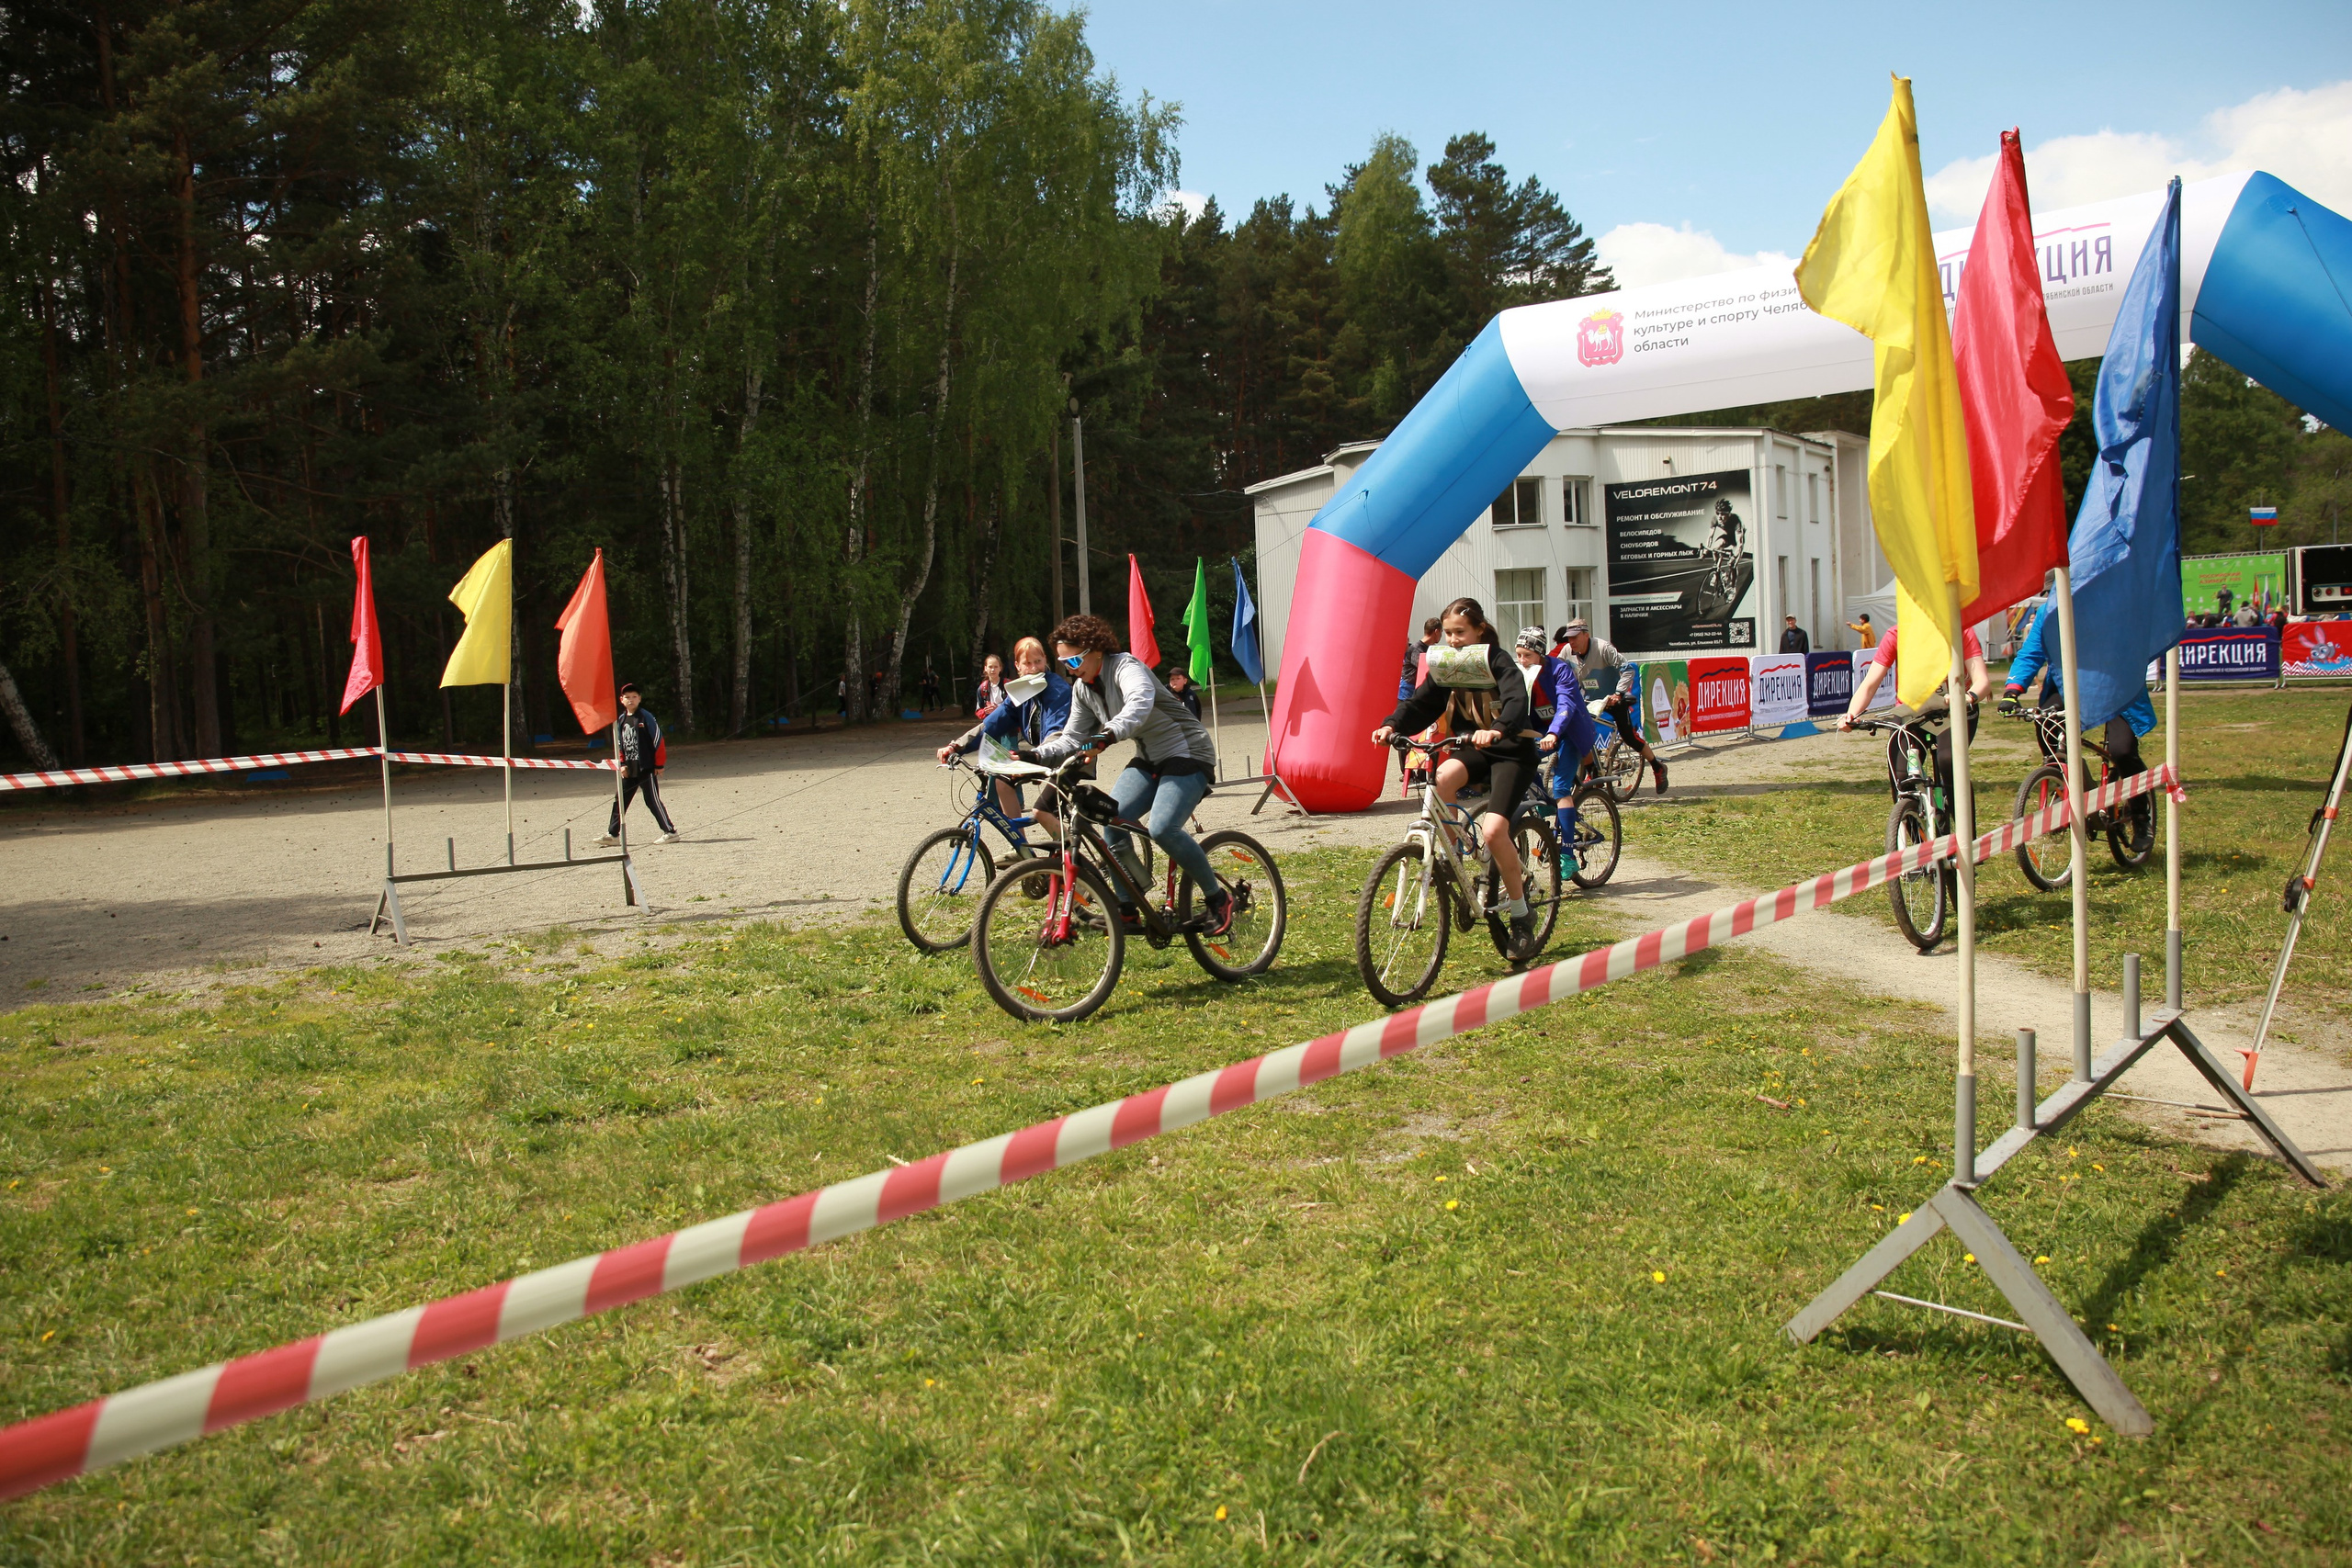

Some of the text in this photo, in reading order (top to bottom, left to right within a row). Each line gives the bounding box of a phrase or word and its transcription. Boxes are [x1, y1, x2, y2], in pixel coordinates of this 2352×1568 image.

[2083, 283, 2113, 295] ОБЛАСТИ
[1634, 288, 1797, 320] Министерство по физи
[1634, 300, 1807, 336] культуре и спорту Челяб
[1634, 337, 1689, 353] области
[1613, 482, 1700, 500] VELOREMONT
[1616, 508, 1705, 523] РЕМОНТ И ОБСЛУЖИВАНИЕ
[1619, 528, 1662, 537] ВЕЛОСИПЕДОВ
[1620, 540, 1659, 549] СНОУБОРДОВ
[1653, 550, 1678, 558] ГОРНЫХ
[1758, 674, 1803, 705] ДИРЕКЦИЯ
[1813, 670, 1850, 699] ДИРЕКЦИЯ
[1697, 678, 1746, 713] ДИРЕКЦИЯ
[983, 807, 1020, 840] STELS
